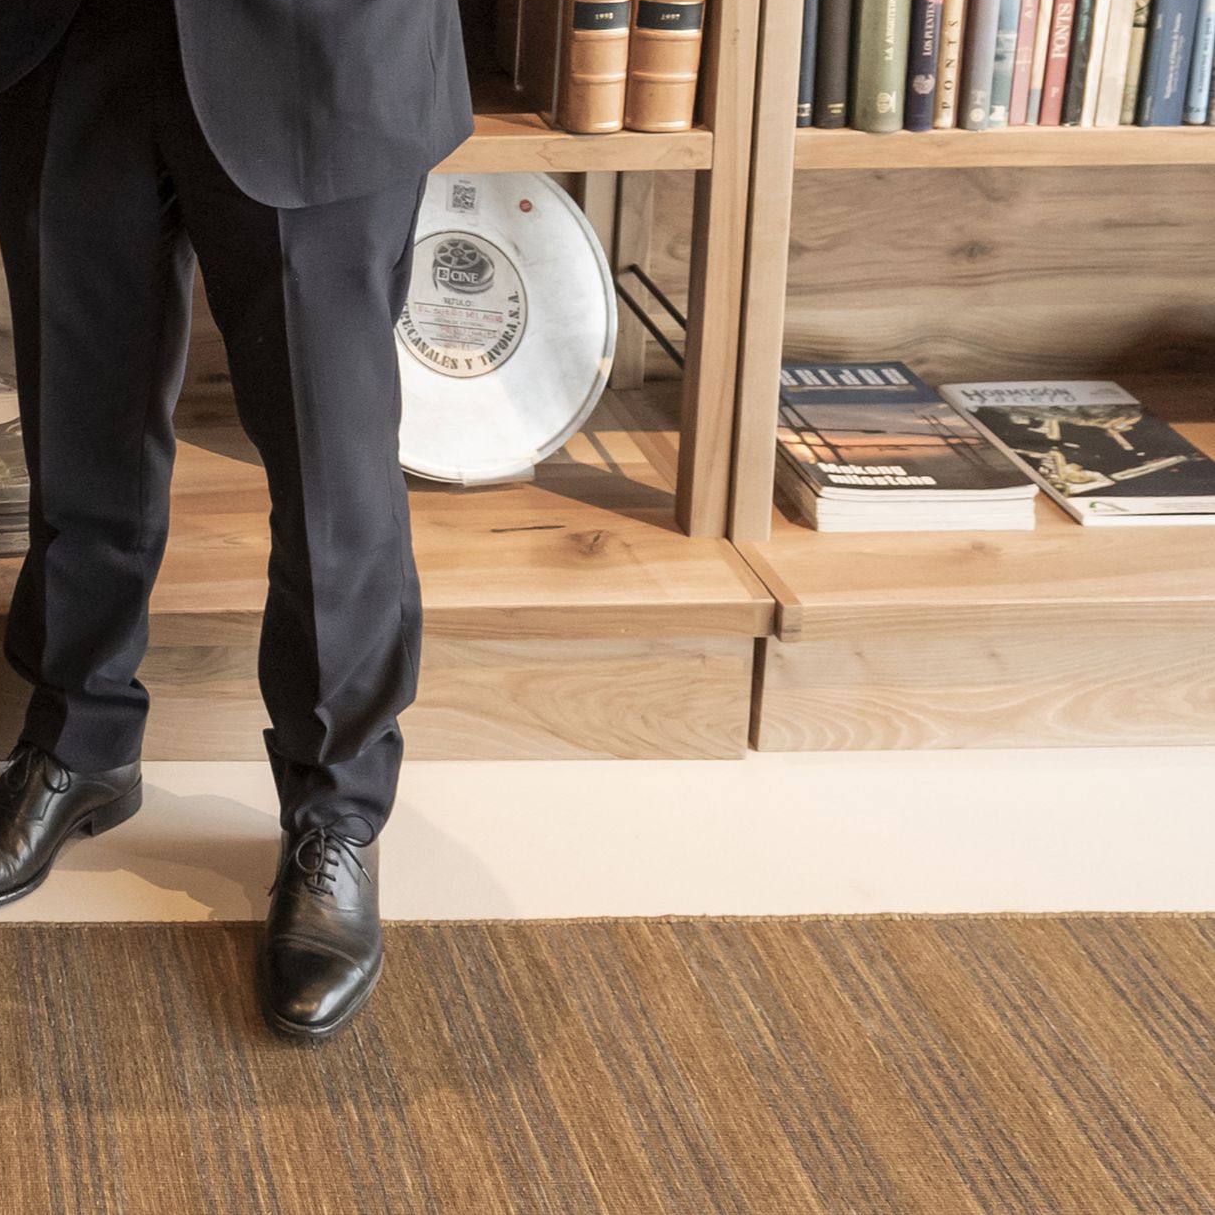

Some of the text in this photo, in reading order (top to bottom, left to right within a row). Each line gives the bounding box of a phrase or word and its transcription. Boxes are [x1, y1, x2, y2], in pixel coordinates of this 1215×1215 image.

[1024, 7, 1034, 19] A
[923, 3, 935, 39] PUENTES
[1051, 3, 1072, 59] PONTS
[885, 47, 894, 61] LA
[921, 39, 933, 56] LOS
[941, 19, 959, 111] PONTS
[450, 271, 479, 283] CINE
[464, 358, 473, 369] Y
[817, 461, 907, 475] Mekong
[827, 473, 937, 485] milestone
